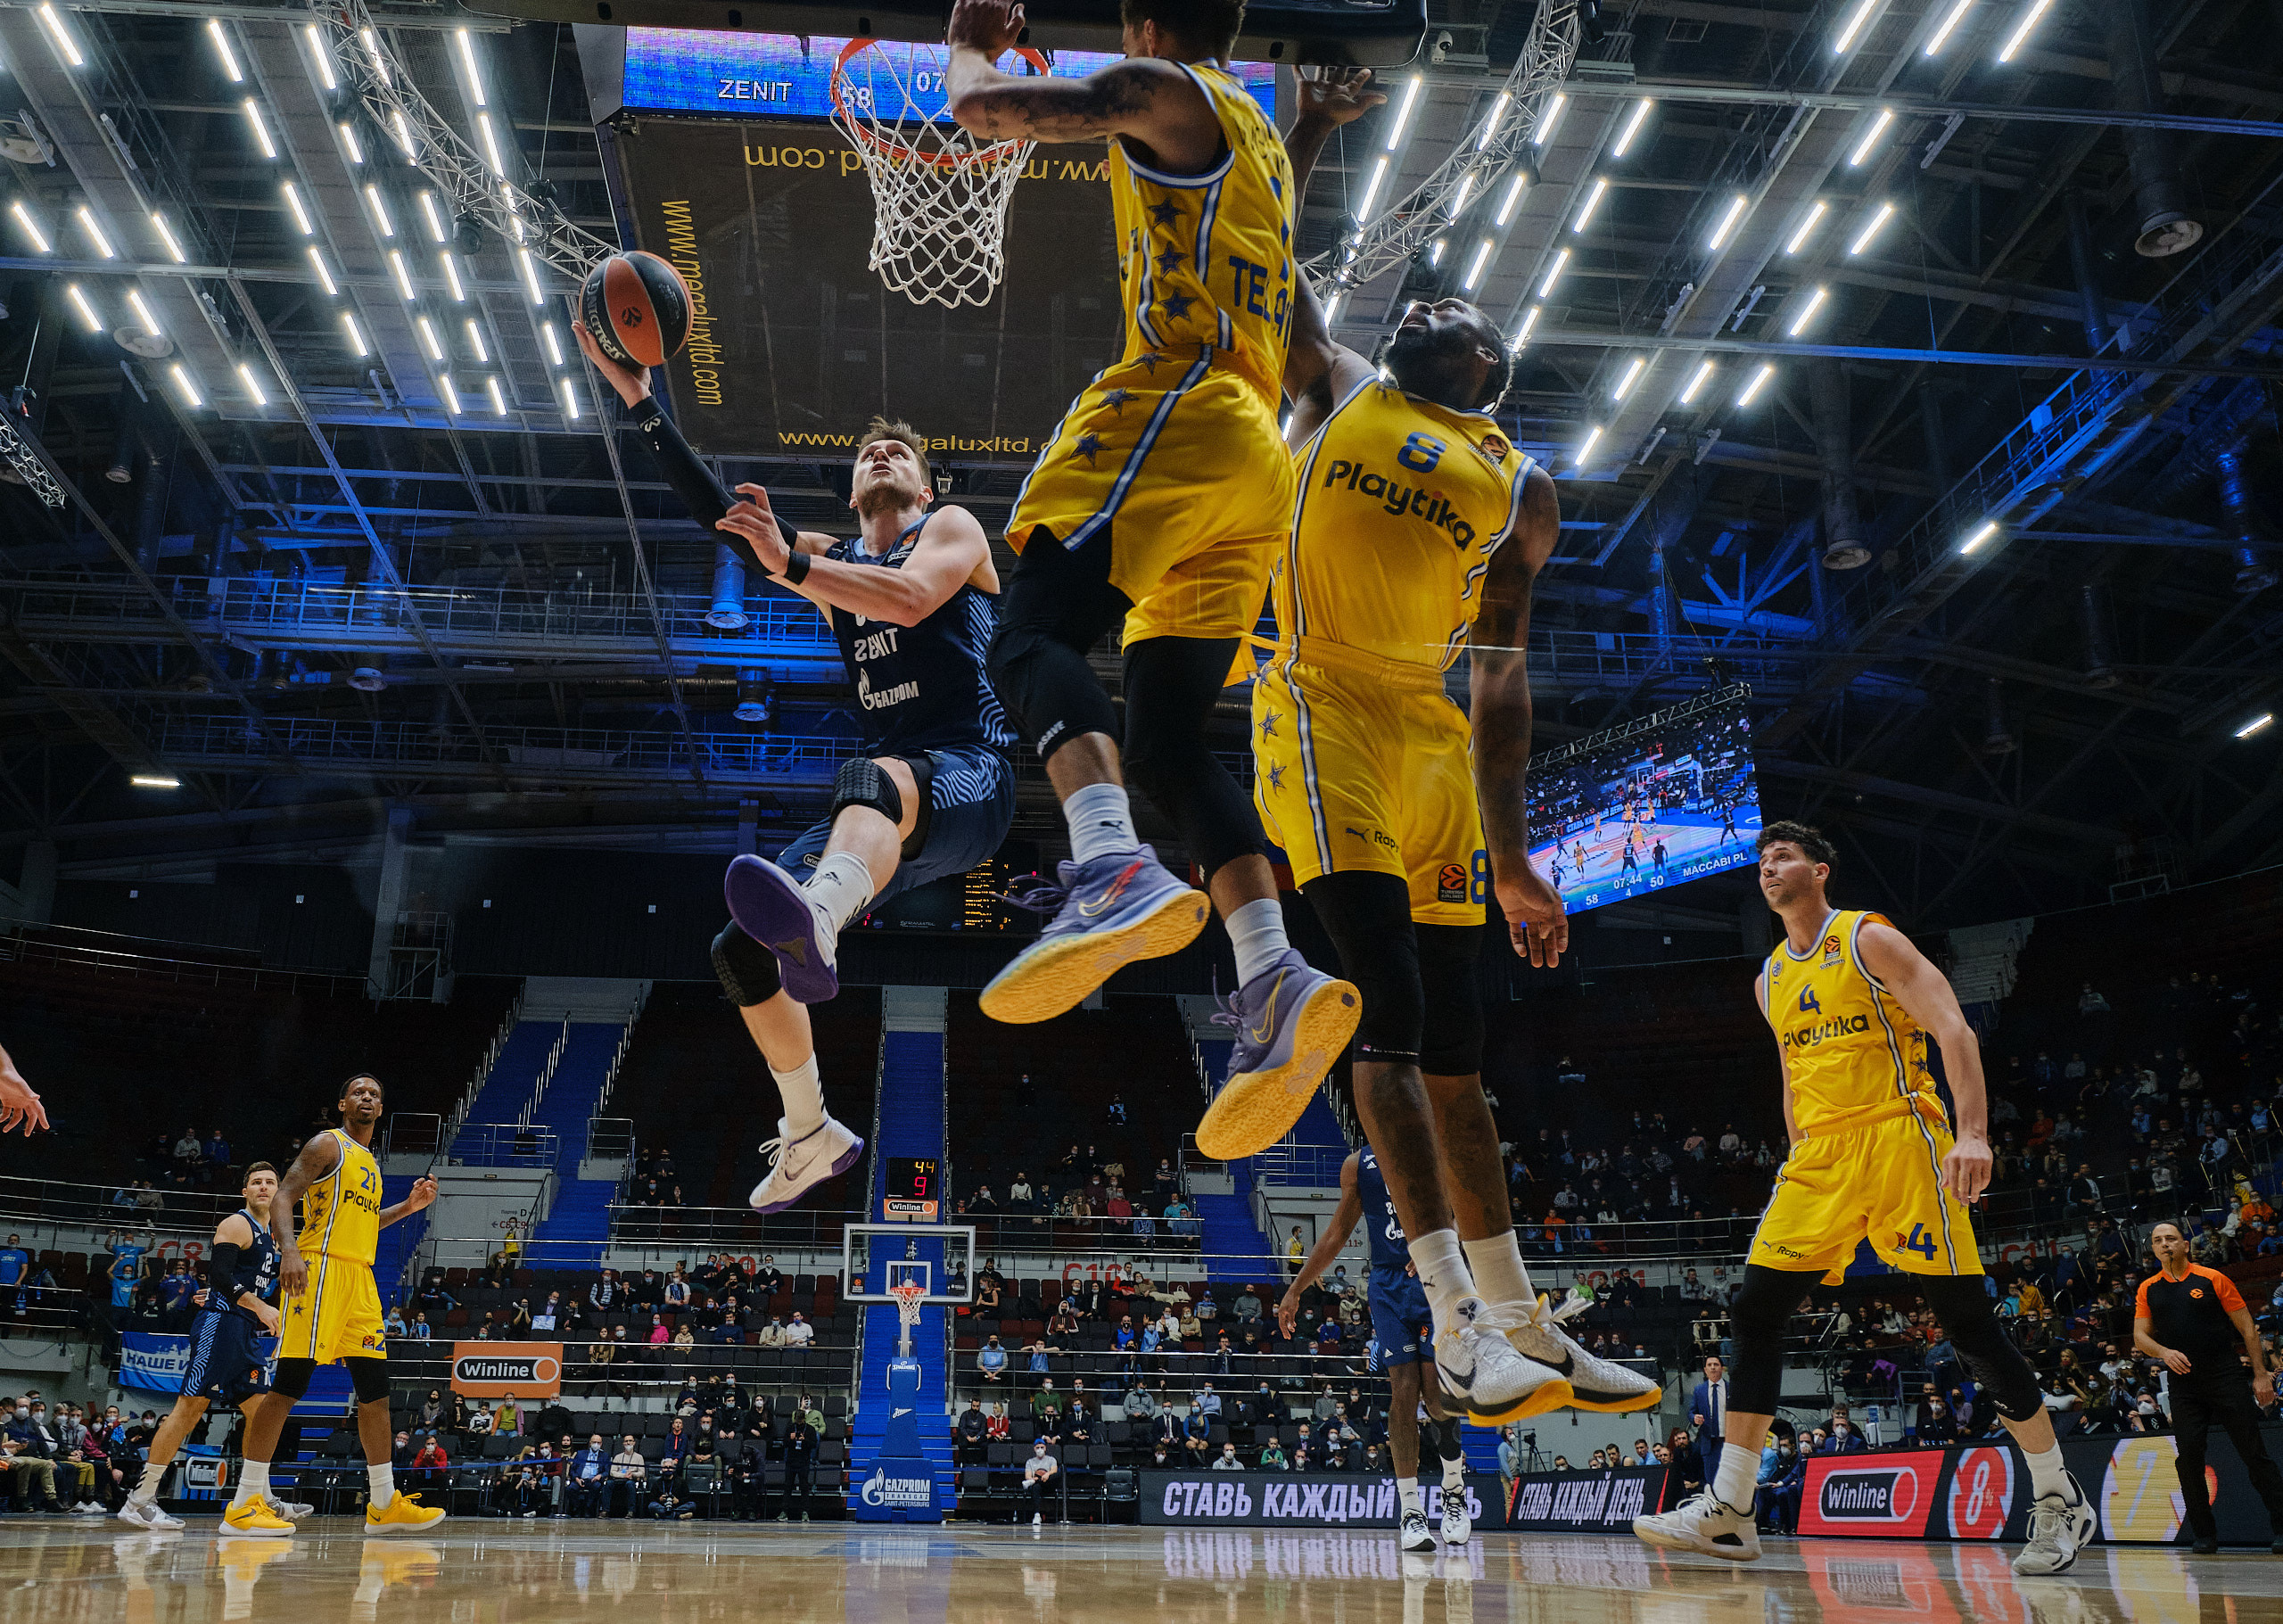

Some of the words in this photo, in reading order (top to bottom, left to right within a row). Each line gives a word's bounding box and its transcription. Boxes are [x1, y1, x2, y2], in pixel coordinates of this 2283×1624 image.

[717, 78, 793, 103] ZENIT
[1397, 431, 1447, 474] 8
[1324, 459, 1476, 552] Playtika
[1470, 849, 1487, 905] 8
[1585, 894, 1599, 906] 58
[1625, 888, 1632, 897] 4
[1650, 875, 1665, 888] 50
[1683, 858, 1732, 878] MACCABI
[1733, 853, 1748, 865] PL
[1613, 875, 1643, 890] 07:44
[1799, 983, 1822, 1015] 4
[1783, 1014, 1871, 1051] Playtika
[359, 1166, 376, 1194] 21
[915, 1161, 935, 1174] 44
[914, 1176, 927, 1196] 9
[343, 1190, 380, 1215] Playtik
[892, 1203, 921, 1211] Winline
[1906, 1223, 1938, 1261] 4
[126, 1353, 176, 1370] НАШЕ
[464, 1362, 530, 1377] Winline
[885, 1479, 931, 1493] GAZPROM
[1518, 1482, 1554, 1521] СТАВЬ
[1551, 1471, 1611, 1526] КАЖДЫЙ
[1603, 1478, 1646, 1526] ДЕНЬ
[1828, 1482, 1887, 1510] Winline
[1162, 1481, 1253, 1517] СТАВЬ
[1262, 1479, 1397, 1522] КАЖДЫЙ
